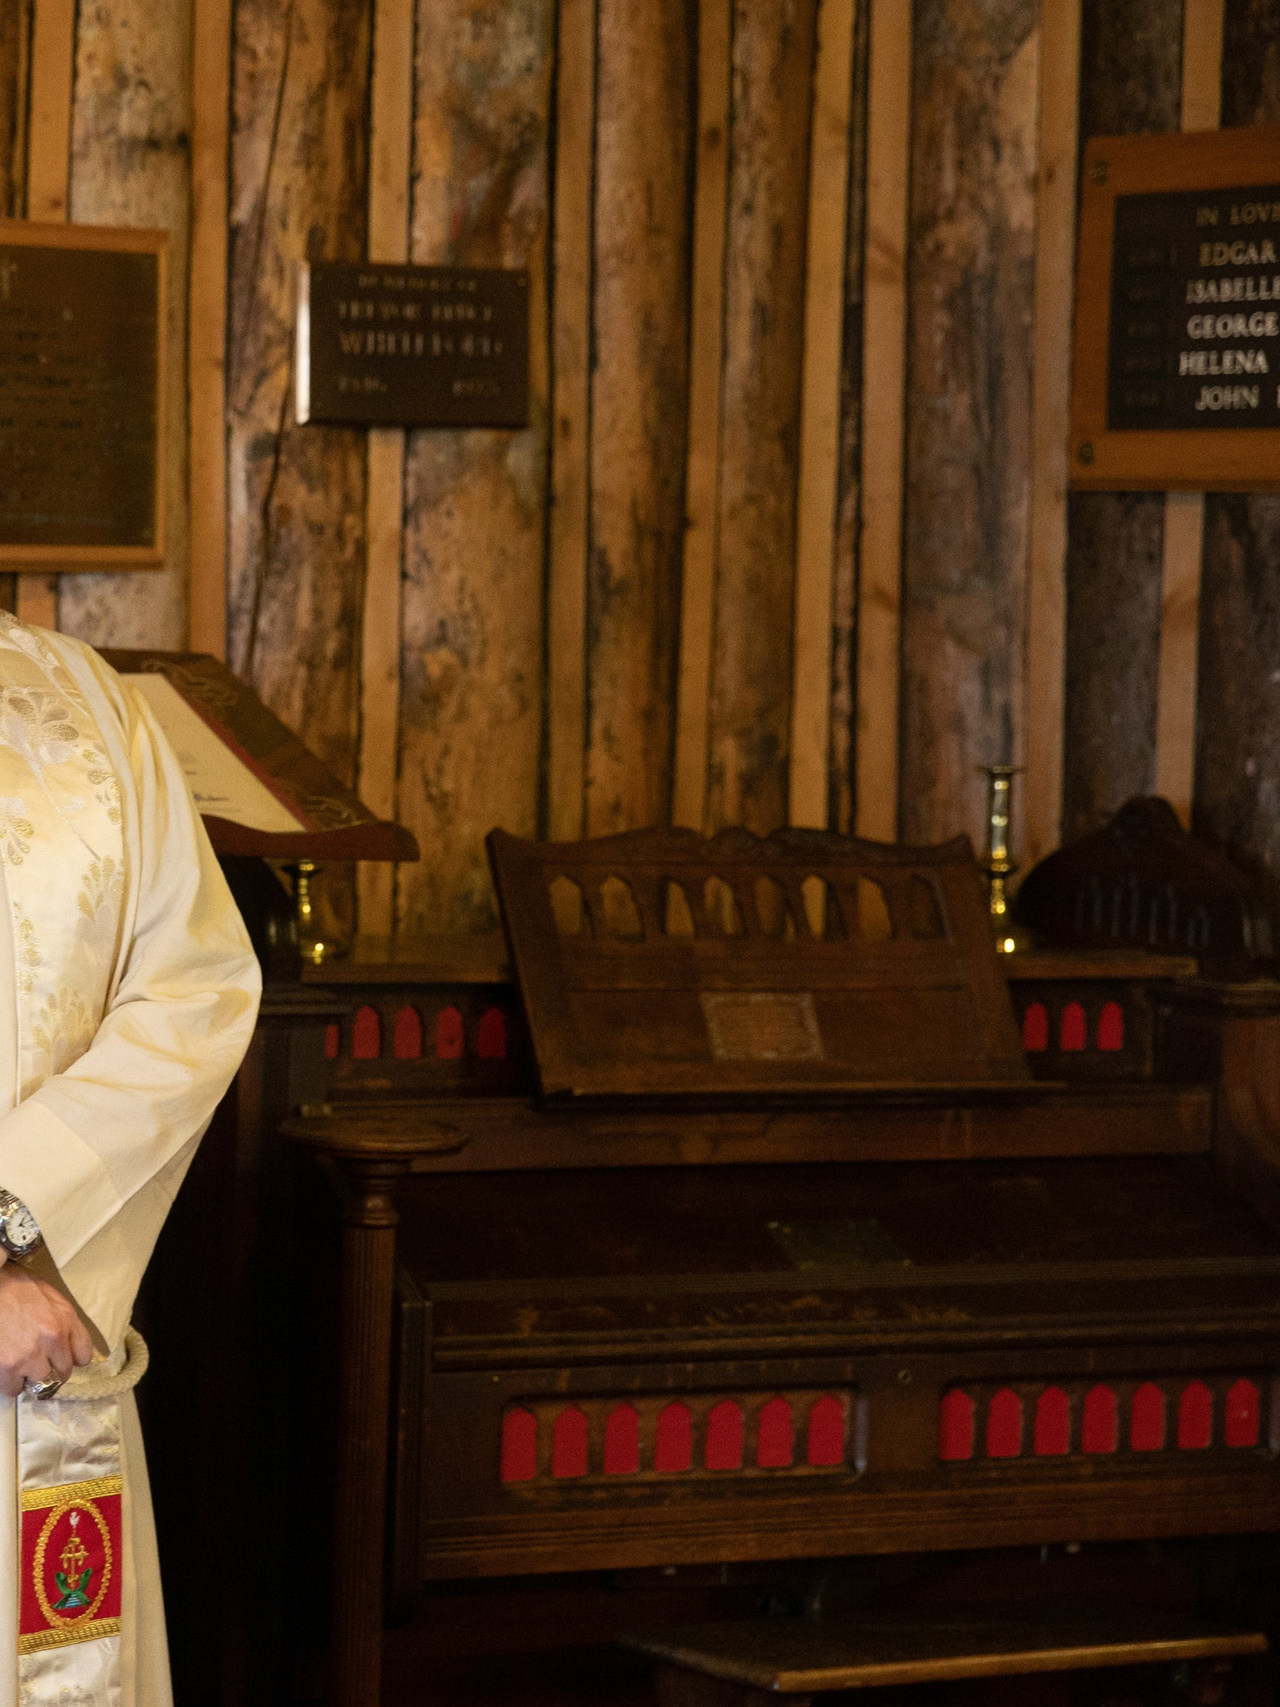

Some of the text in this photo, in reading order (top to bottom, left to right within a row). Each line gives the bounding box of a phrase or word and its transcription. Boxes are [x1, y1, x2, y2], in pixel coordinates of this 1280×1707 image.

[1199, 239, 1276, 267] EDGAR
[1187, 311, 1279, 340] GEORGE
[1179, 349, 1269, 376] HELENA
[1195, 385, 1260, 411] JOHN
